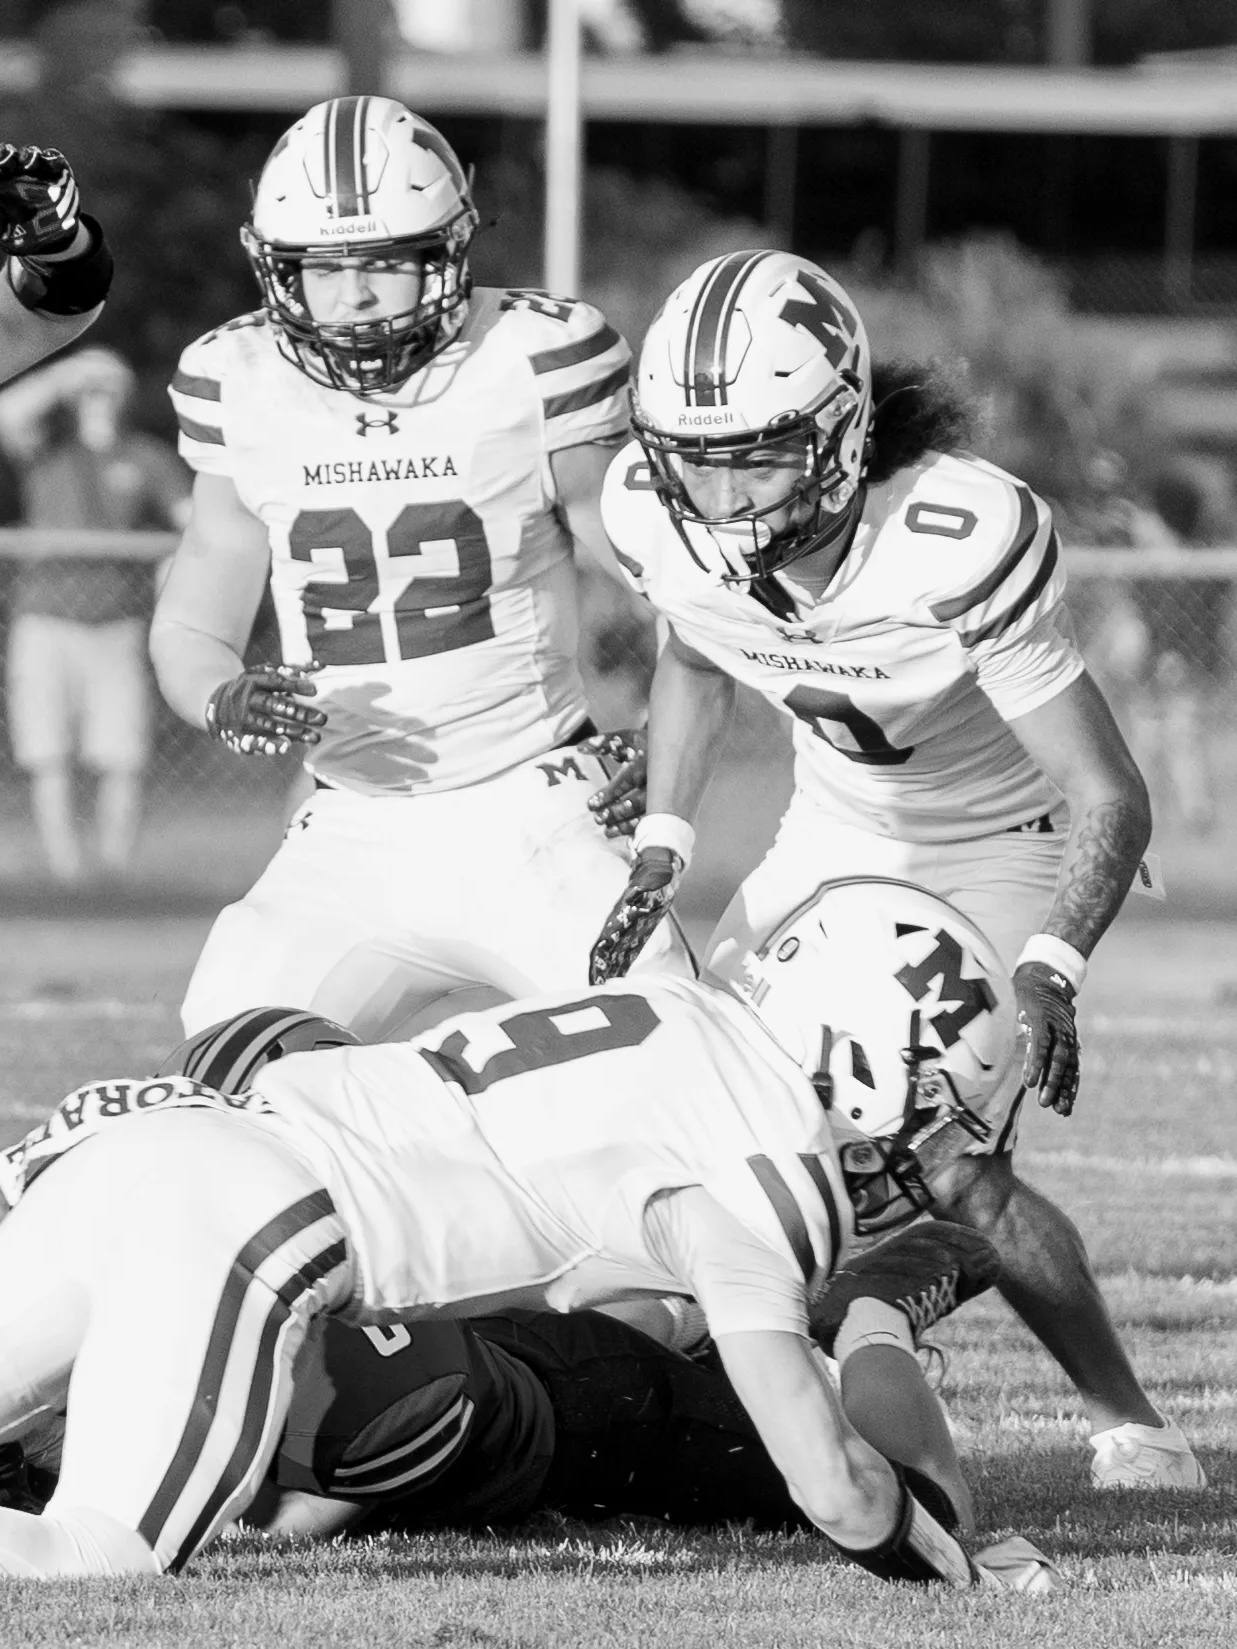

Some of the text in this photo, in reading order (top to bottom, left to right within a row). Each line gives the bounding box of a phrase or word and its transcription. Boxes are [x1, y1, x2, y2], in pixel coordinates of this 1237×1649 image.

[678, 411, 734, 426] Riddell
[303, 455, 459, 486] MISHAWAKA
[904, 501, 979, 540] 0
[288, 498, 497, 667] 22
[740, 648, 891, 680] MISHAWAKA
[535, 756, 589, 788] M
[893, 927, 1000, 1050] M
